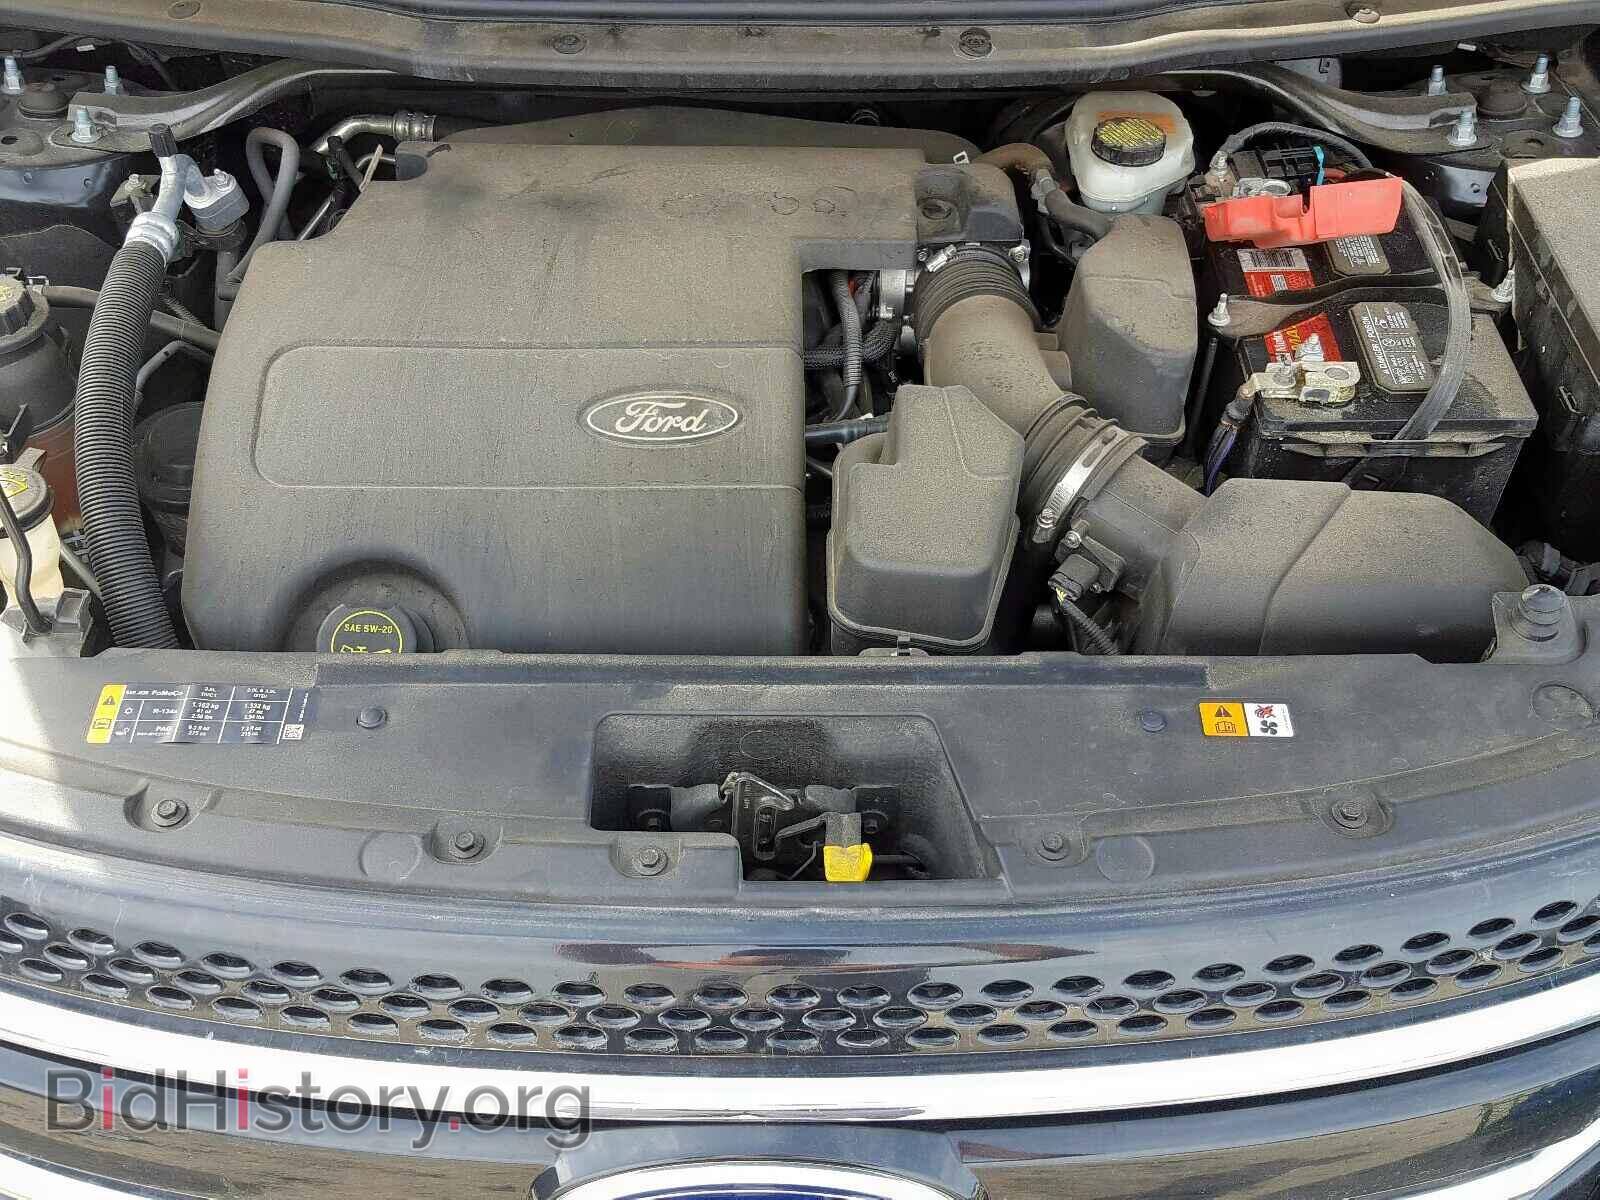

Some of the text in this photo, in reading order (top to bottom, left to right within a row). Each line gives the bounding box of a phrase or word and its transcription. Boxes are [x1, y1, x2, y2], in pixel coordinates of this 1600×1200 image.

[1360, 316, 1375, 338] POISON
[615, 401, 709, 433] Ford
[343, 623, 393, 634] SAE 5W-20
